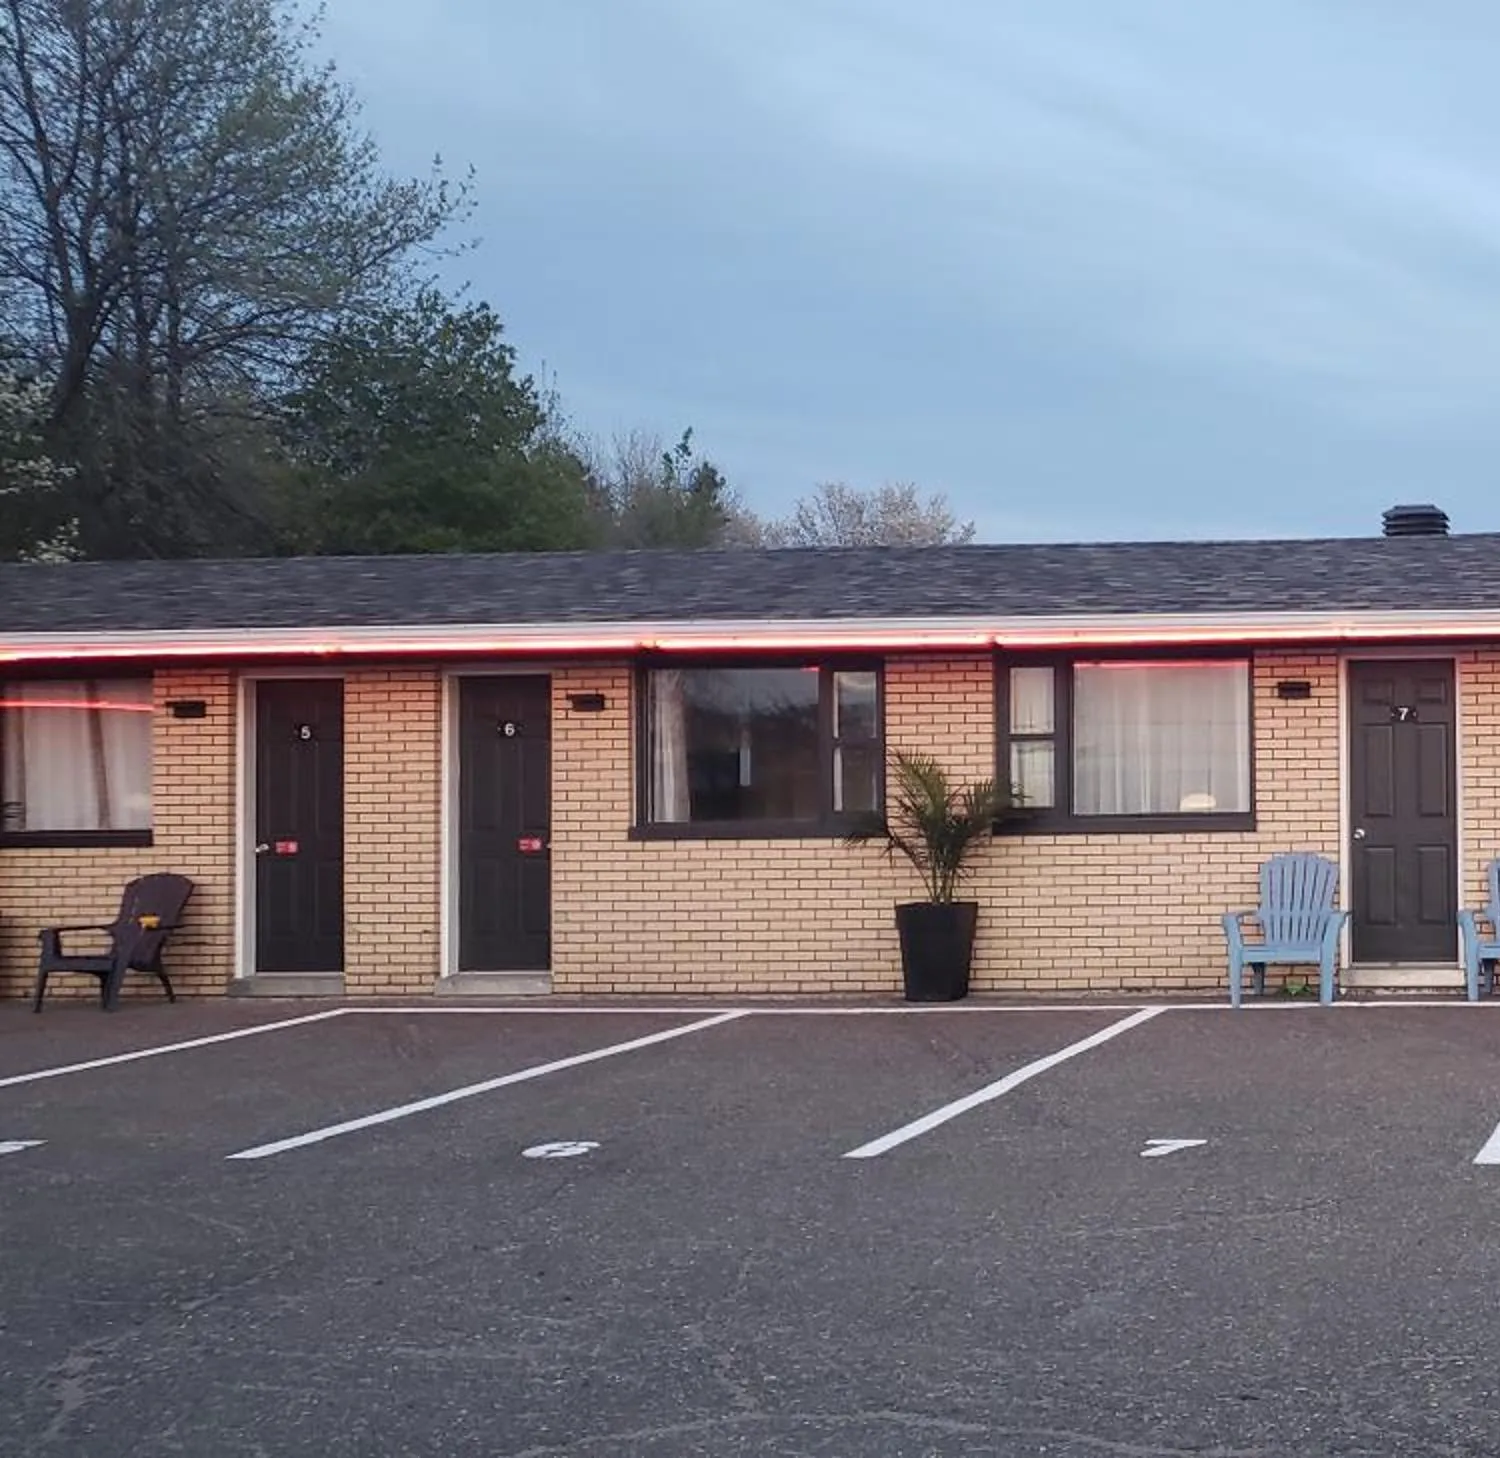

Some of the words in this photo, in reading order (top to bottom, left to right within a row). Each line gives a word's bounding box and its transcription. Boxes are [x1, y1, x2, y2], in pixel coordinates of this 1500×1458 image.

[1398, 707, 1409, 721] 7
[301, 725, 311, 739] 5
[504, 723, 515, 737] 6
[1140, 1139, 1208, 1157] 7
